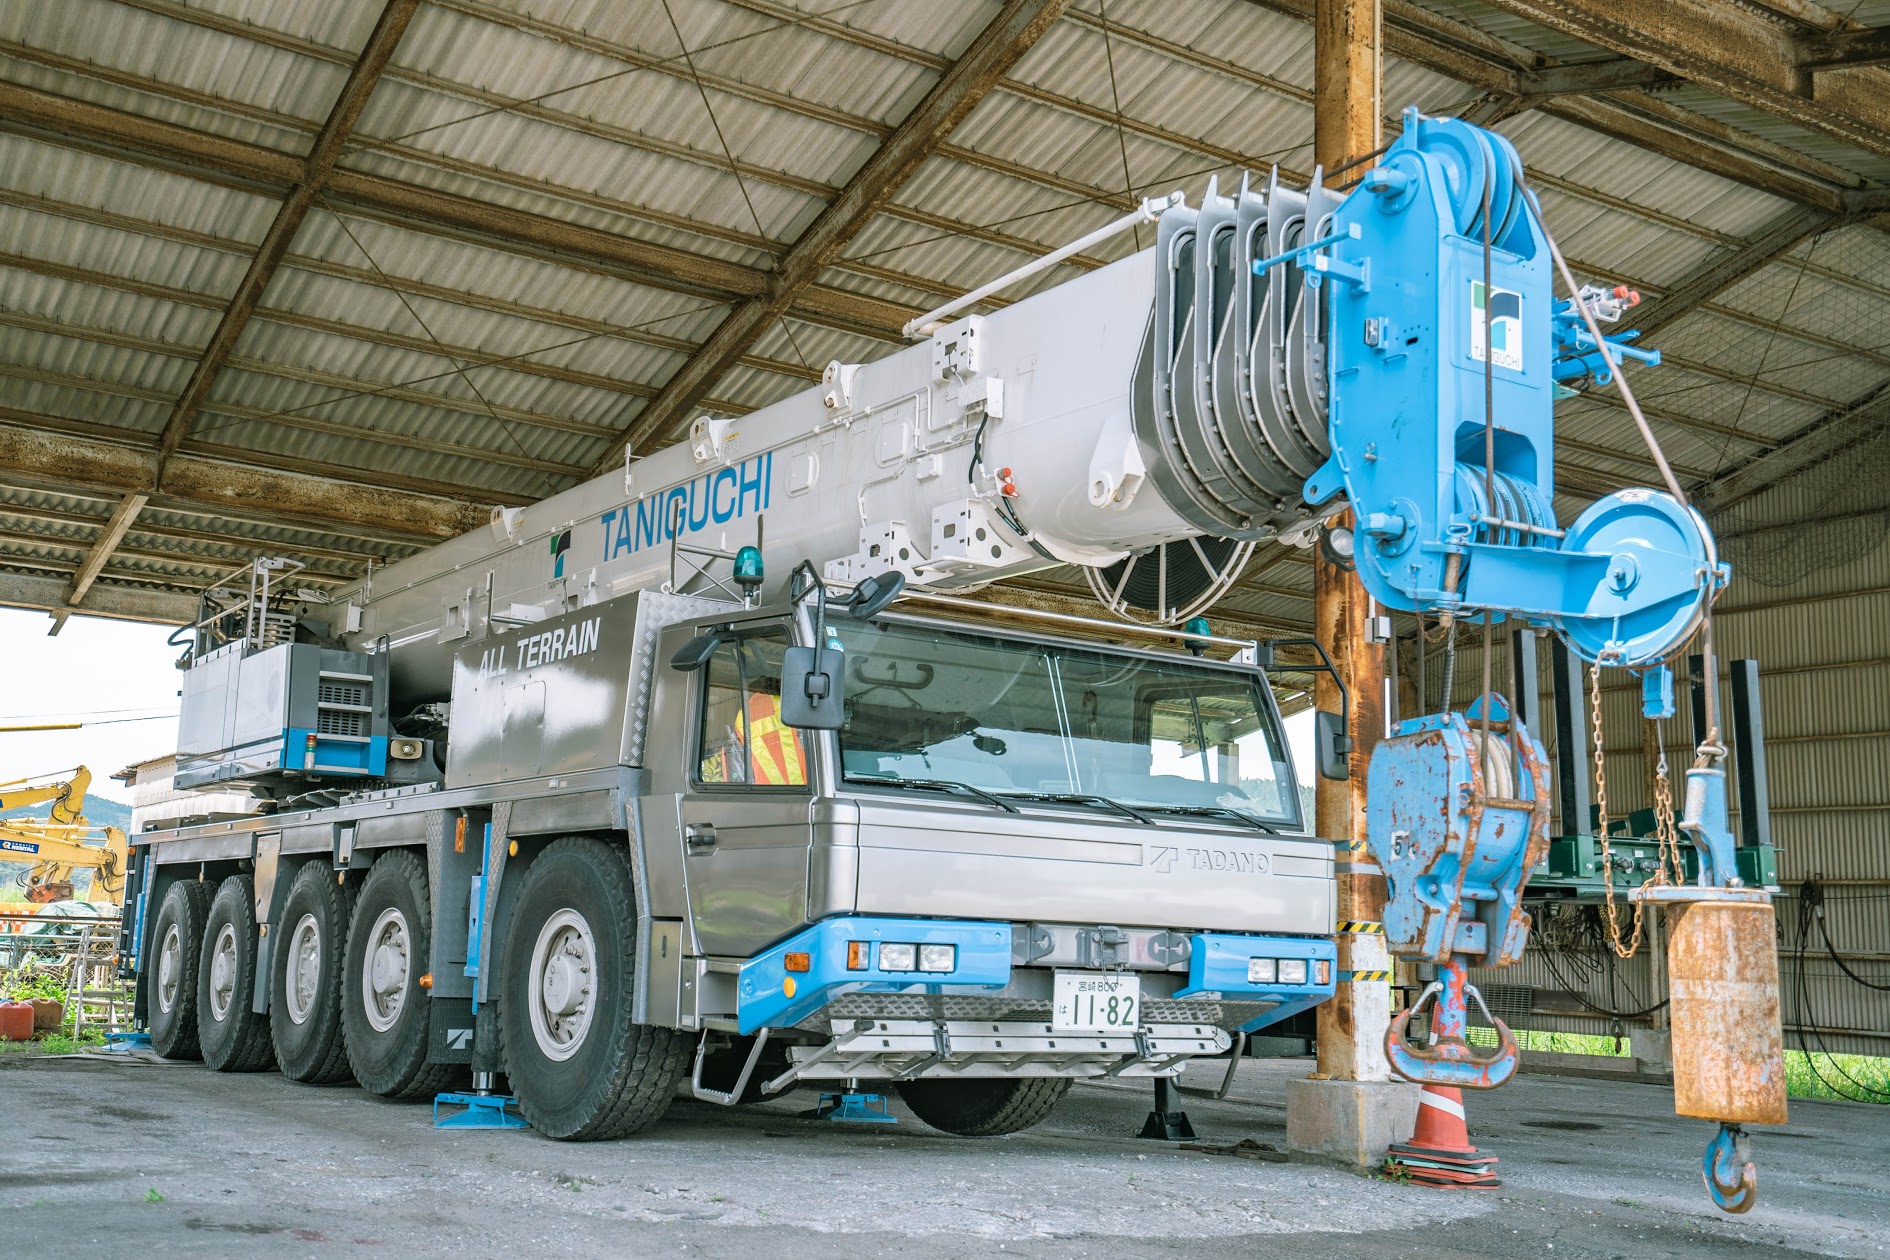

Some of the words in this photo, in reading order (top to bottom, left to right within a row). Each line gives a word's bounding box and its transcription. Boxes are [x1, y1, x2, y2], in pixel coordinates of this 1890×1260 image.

[601, 451, 772, 561] TANIGUCHI
[478, 645, 507, 681] ALL
[517, 617, 601, 671] TERRAIN
[1187, 848, 1269, 874] TADANO
[1059, 1004, 1067, 1014] は
[1073, 994, 1134, 1026] 11-82
